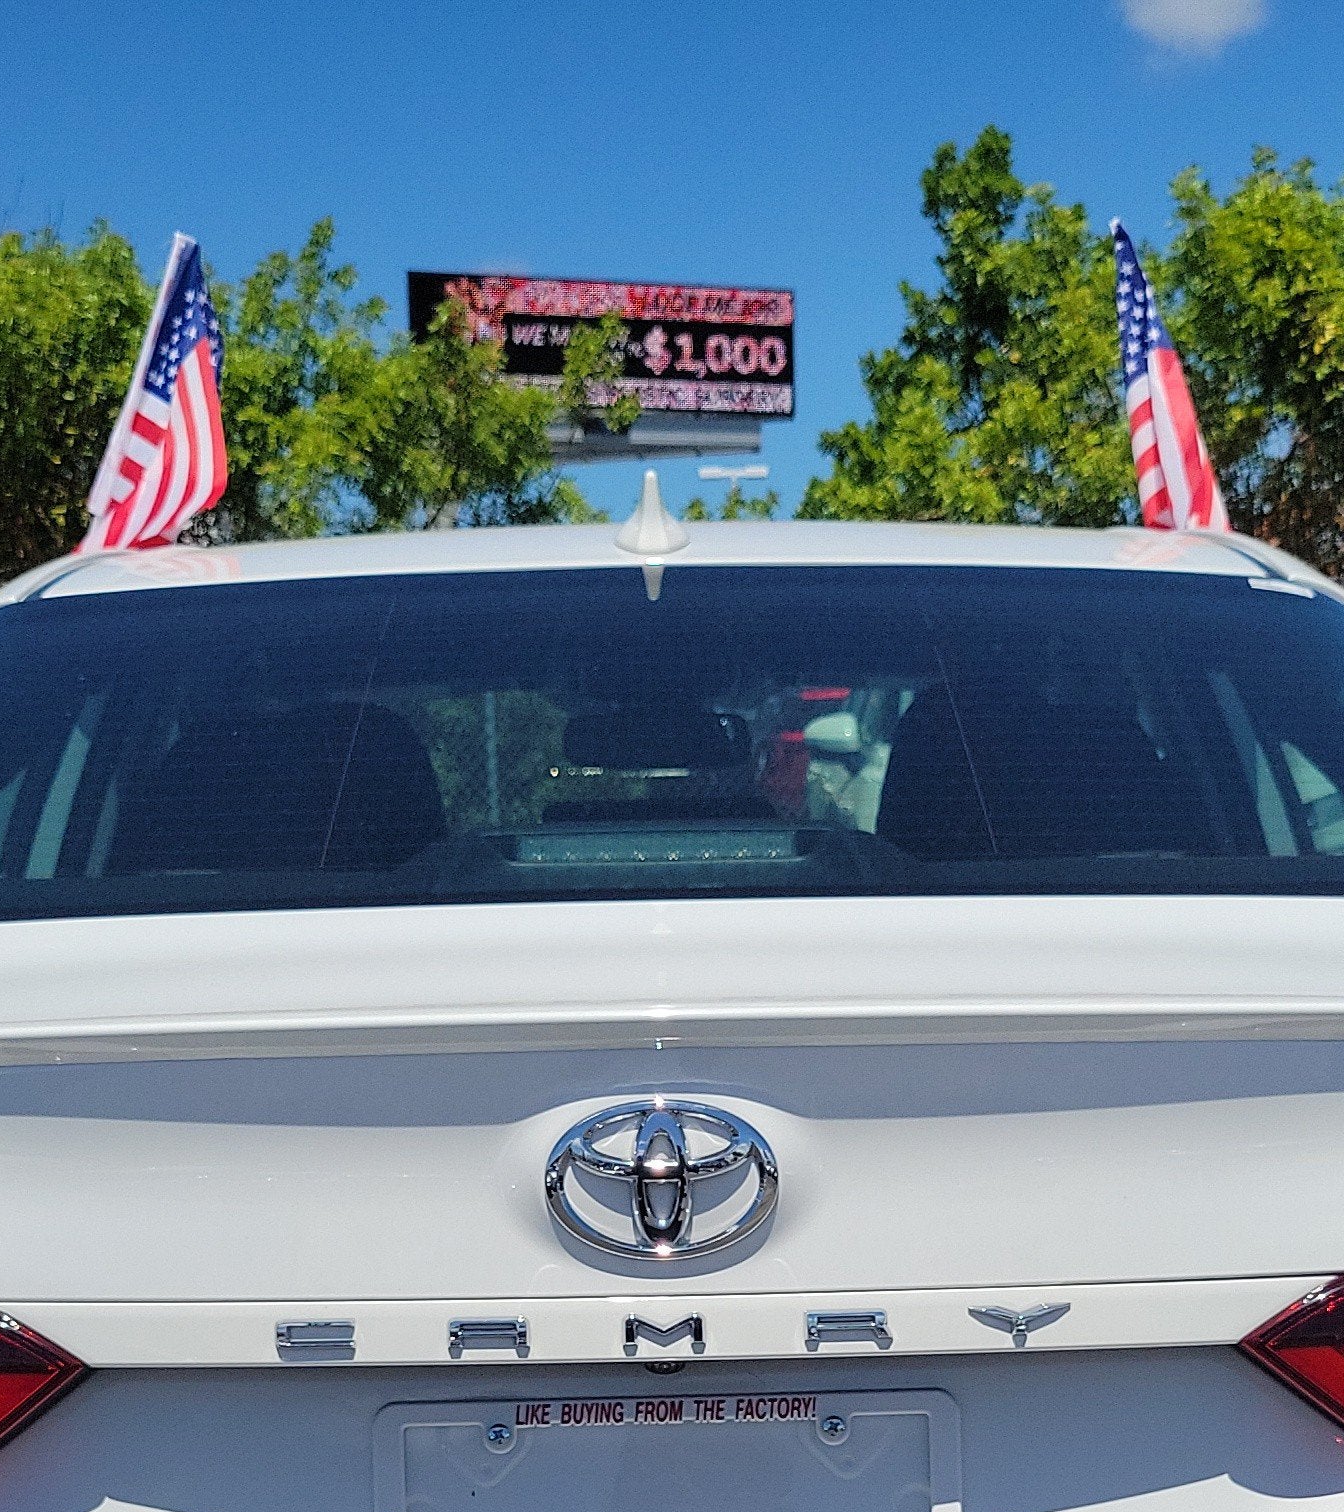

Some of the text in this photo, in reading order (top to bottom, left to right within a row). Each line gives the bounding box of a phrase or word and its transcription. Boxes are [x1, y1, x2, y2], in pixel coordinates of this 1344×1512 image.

[643, 324, 788, 378] $1,000
[274, 1301, 1072, 1359] CAMRY
[515, 1397, 817, 1426] LIKE BUYING FROM THE FACTORY!
